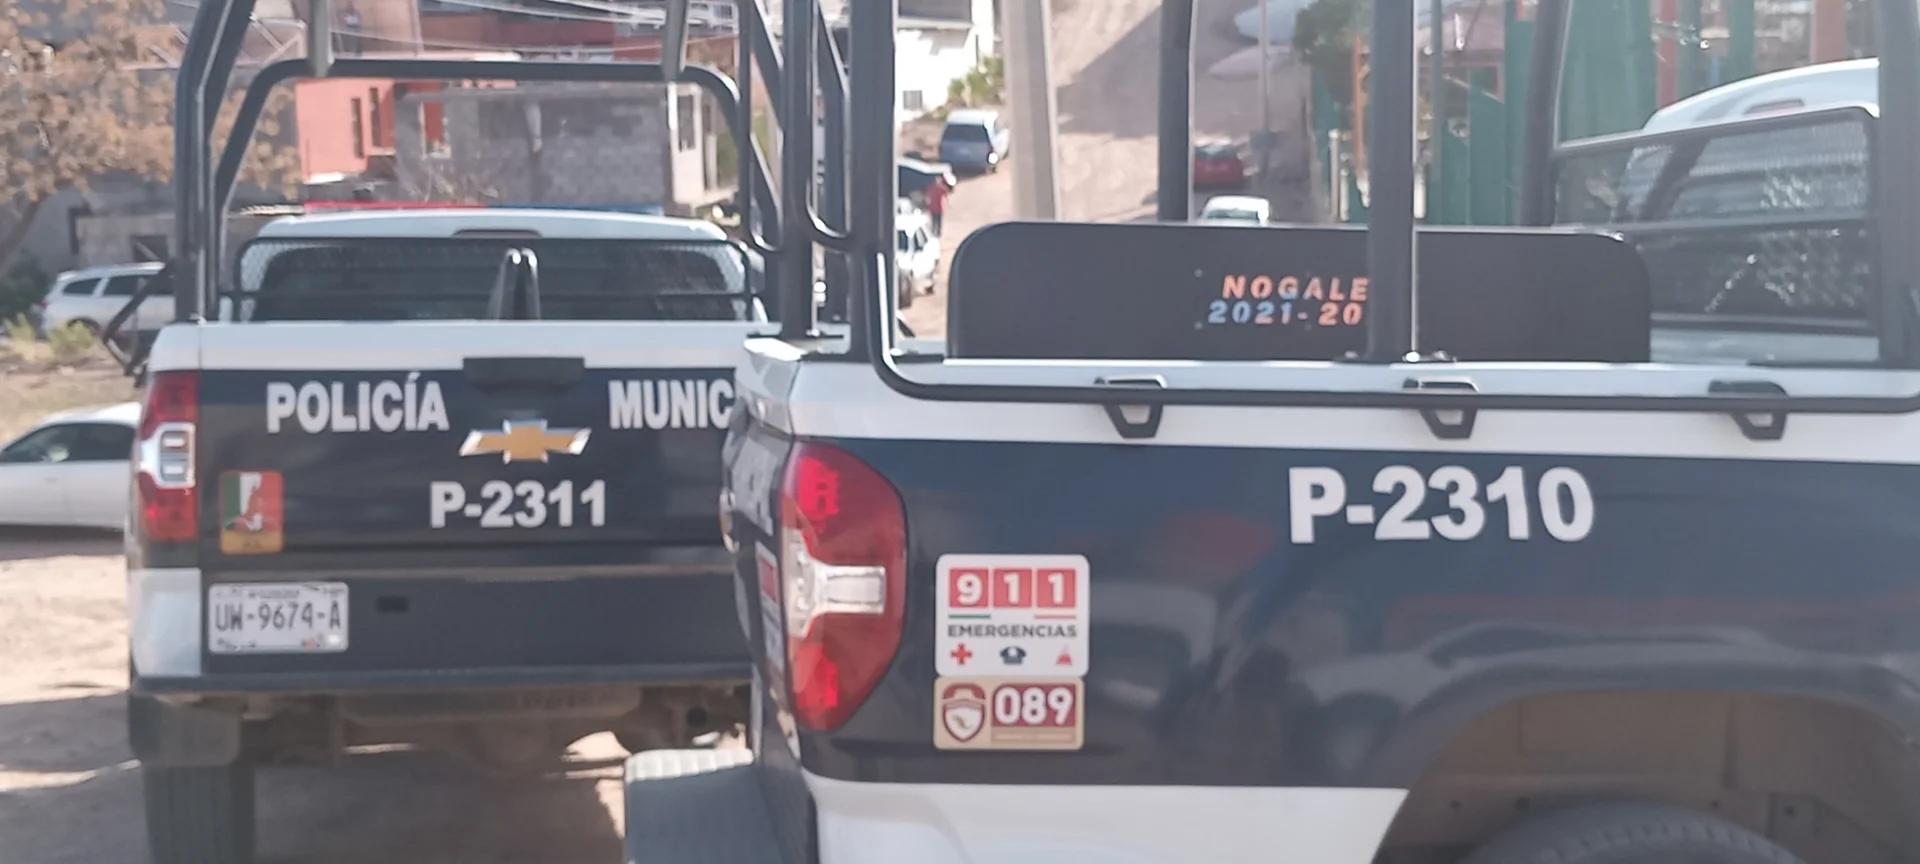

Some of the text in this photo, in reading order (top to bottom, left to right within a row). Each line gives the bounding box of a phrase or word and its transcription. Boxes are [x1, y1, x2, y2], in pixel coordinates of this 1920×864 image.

[266, 372, 734, 433] POLICÍA MUNIC
[430, 479, 605, 528] P-2311
[1289, 465, 1594, 543] P-2310
[215, 601, 341, 631] UW-9674-A
[947, 624, 1077, 638] EMERGENCIAS
[994, 687, 1073, 725] 089
